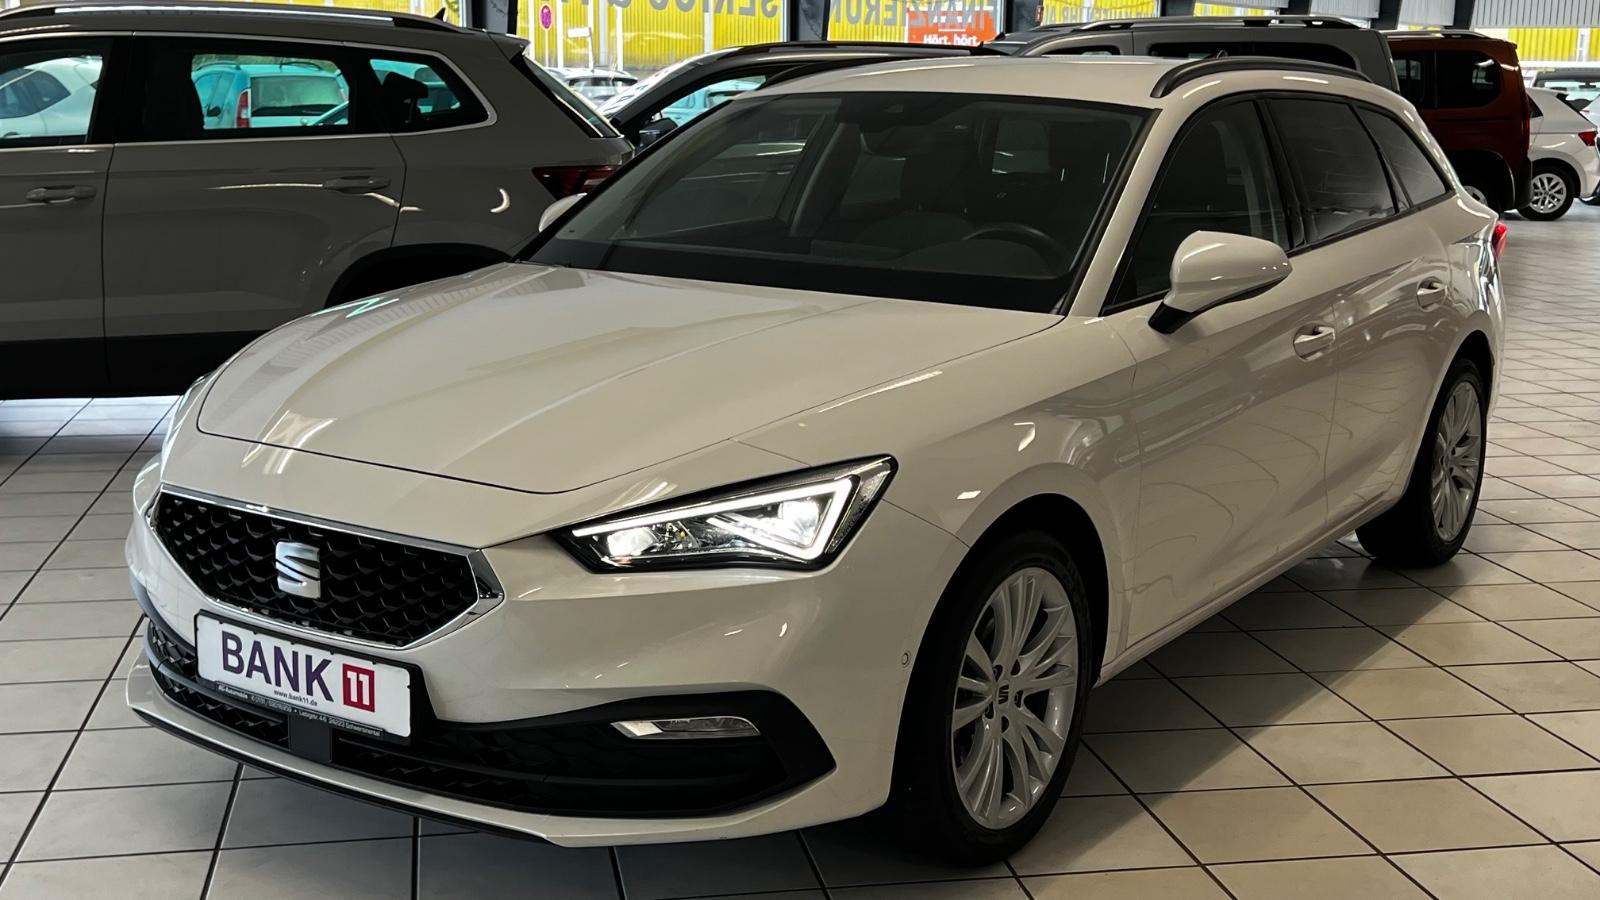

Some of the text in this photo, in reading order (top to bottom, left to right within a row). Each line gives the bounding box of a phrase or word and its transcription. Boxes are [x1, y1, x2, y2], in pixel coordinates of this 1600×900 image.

[222, 630, 370, 706] BANK 11
[274, 689, 318, 707] www.bank11.de
